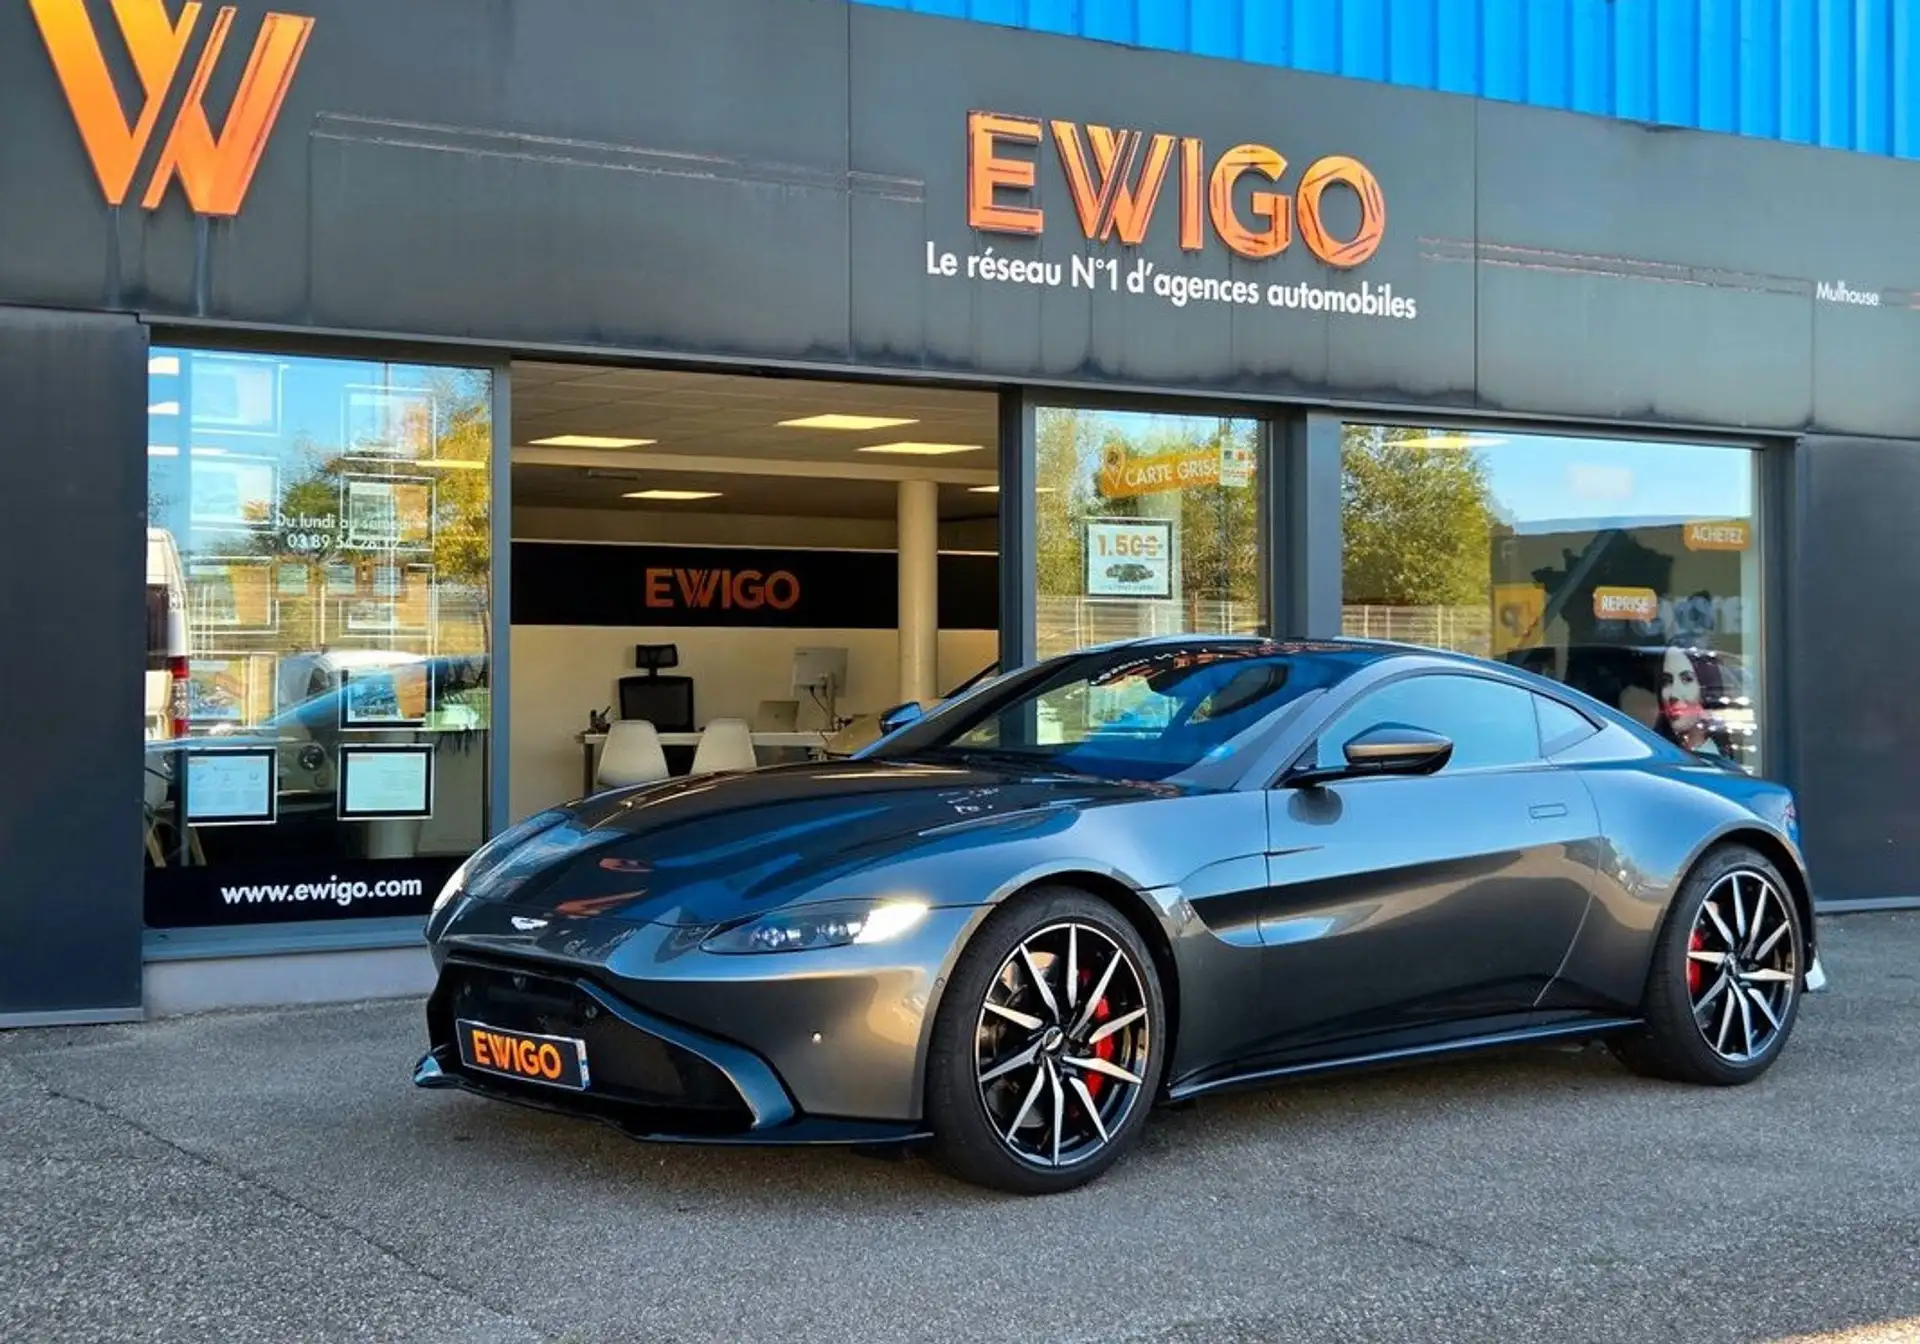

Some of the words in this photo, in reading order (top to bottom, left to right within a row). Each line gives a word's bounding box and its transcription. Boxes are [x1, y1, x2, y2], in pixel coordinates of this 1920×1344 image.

[967, 110, 1386, 268] EWIGO
[926, 241, 958, 276] Le
[968, 246, 1061, 286] réseau
[1071, 254, 1118, 291] N°1
[1267, 281, 1418, 319] automobiles
[1816, 280, 1879, 306] Mulhouse
[1125, 465, 1172, 488] CARTE
[276, 513, 295, 529] Du
[300, 512, 335, 529] lundi
[646, 568, 800, 610] EWIGO
[1601, 594, 1650, 613] REPRISE
[220, 874, 423, 907] www.ewigo.com
[471, 1029, 562, 1079] EWIGO
